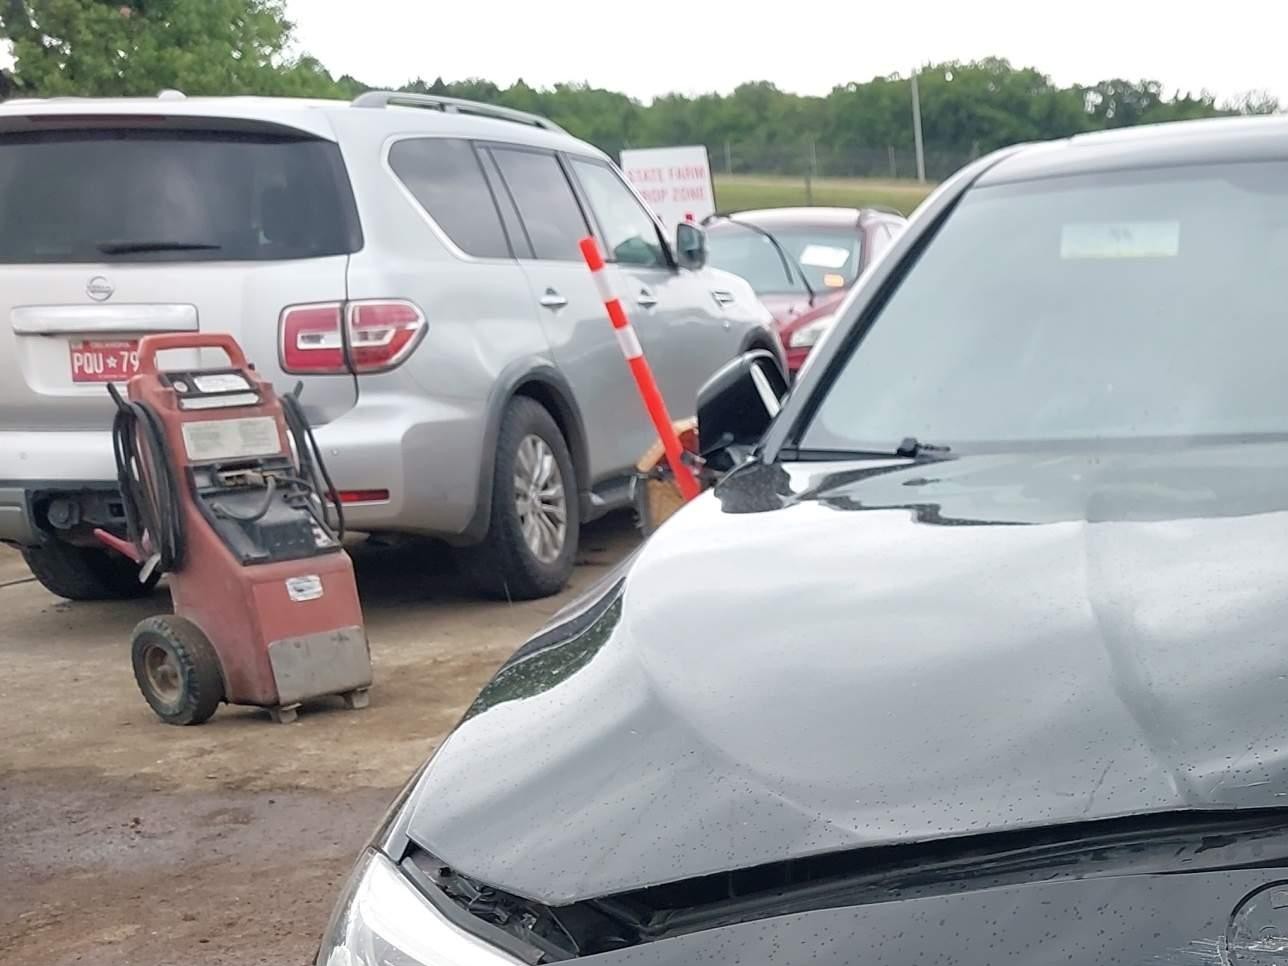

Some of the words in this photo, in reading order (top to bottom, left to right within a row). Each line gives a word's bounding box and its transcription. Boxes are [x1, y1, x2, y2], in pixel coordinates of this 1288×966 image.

[627, 168, 662, 182] STATE
[668, 165, 704, 180] FARM
[672, 187, 704, 202] ZONE
[119, 351, 139, 372] 79
